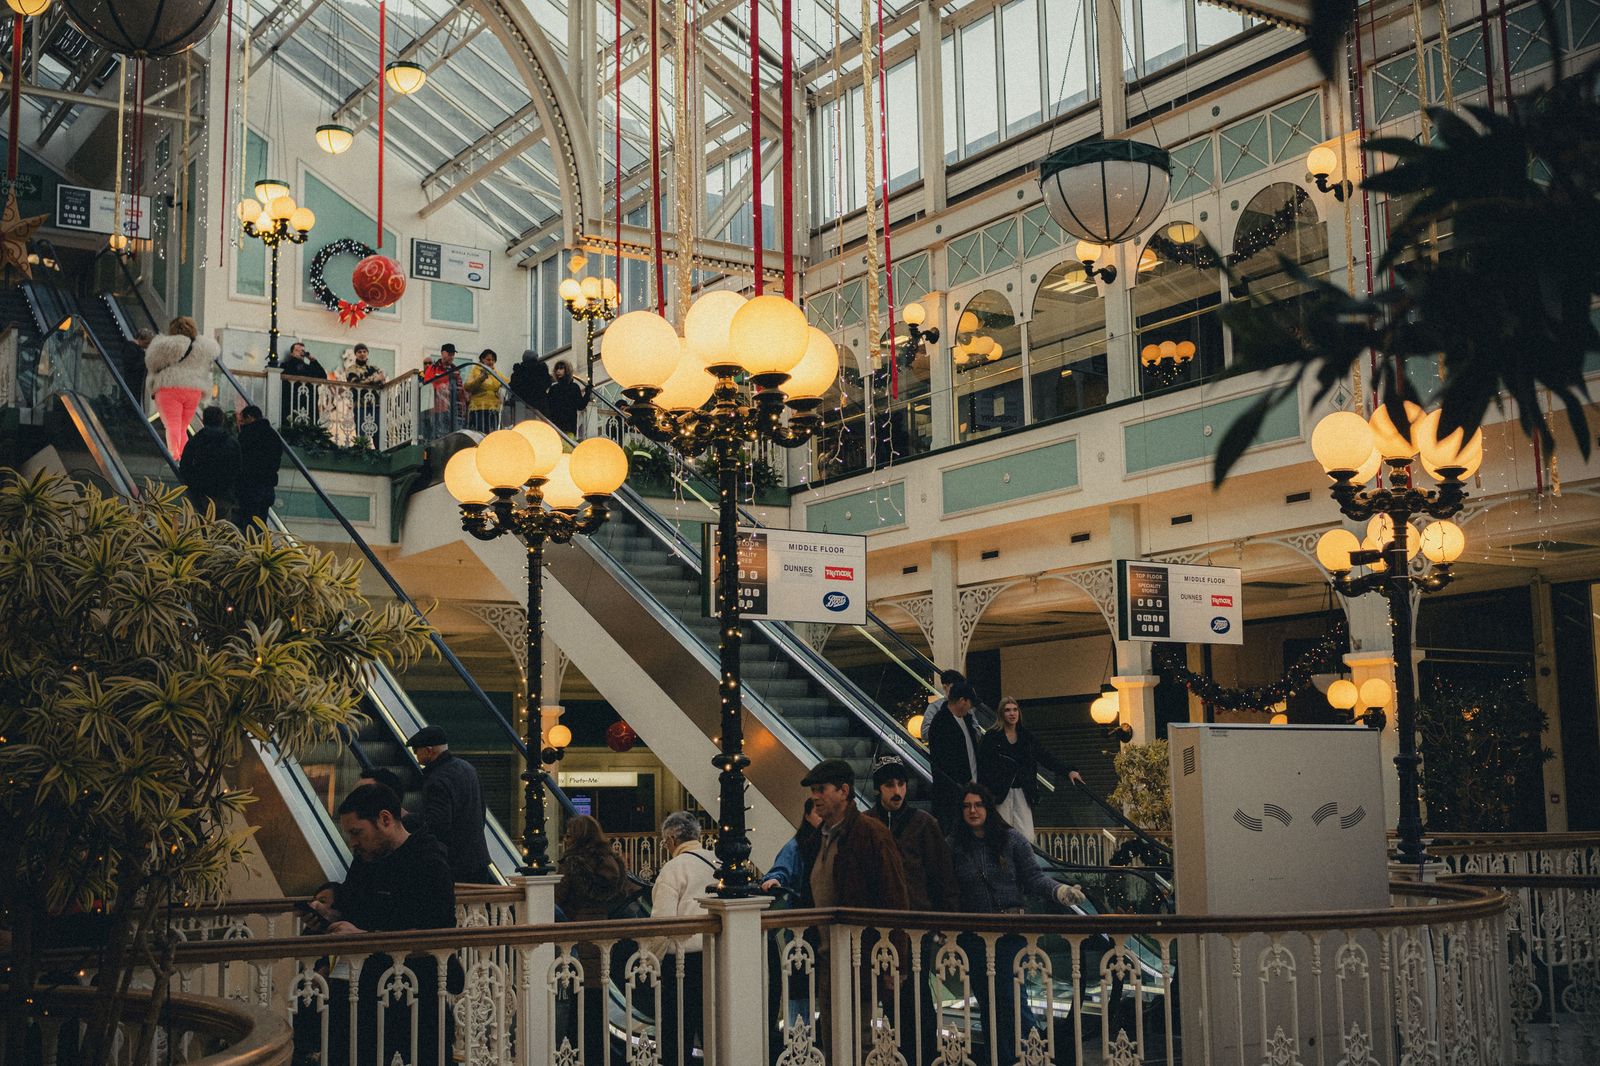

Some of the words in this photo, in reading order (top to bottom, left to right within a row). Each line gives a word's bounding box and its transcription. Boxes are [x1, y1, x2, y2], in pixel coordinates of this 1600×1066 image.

[788, 543, 818, 552] MIDDLE
[820, 545, 845, 554] FLOOR
[784, 564, 813, 574] DUNNES
[1184, 575, 1206, 583] MIDDLE
